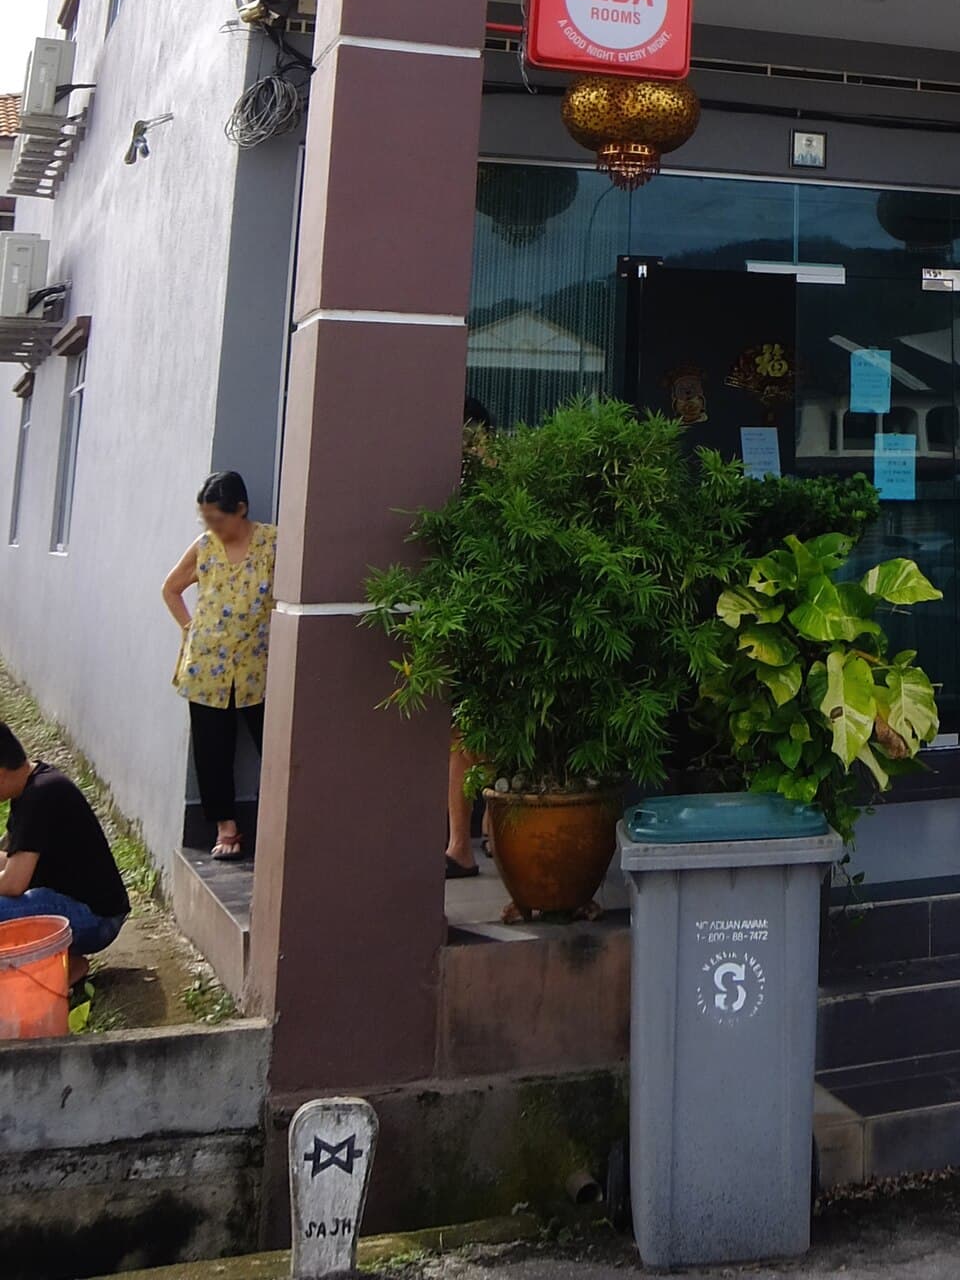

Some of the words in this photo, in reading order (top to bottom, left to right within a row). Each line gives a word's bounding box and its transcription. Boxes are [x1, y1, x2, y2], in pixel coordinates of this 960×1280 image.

[590, 7, 641, 25] ROOMS
[557, 19, 568, 28] A
[563, 26, 586, 49] GOOD
[618, 49, 647, 63] EVERY
[754, 343, 789, 378] 福
